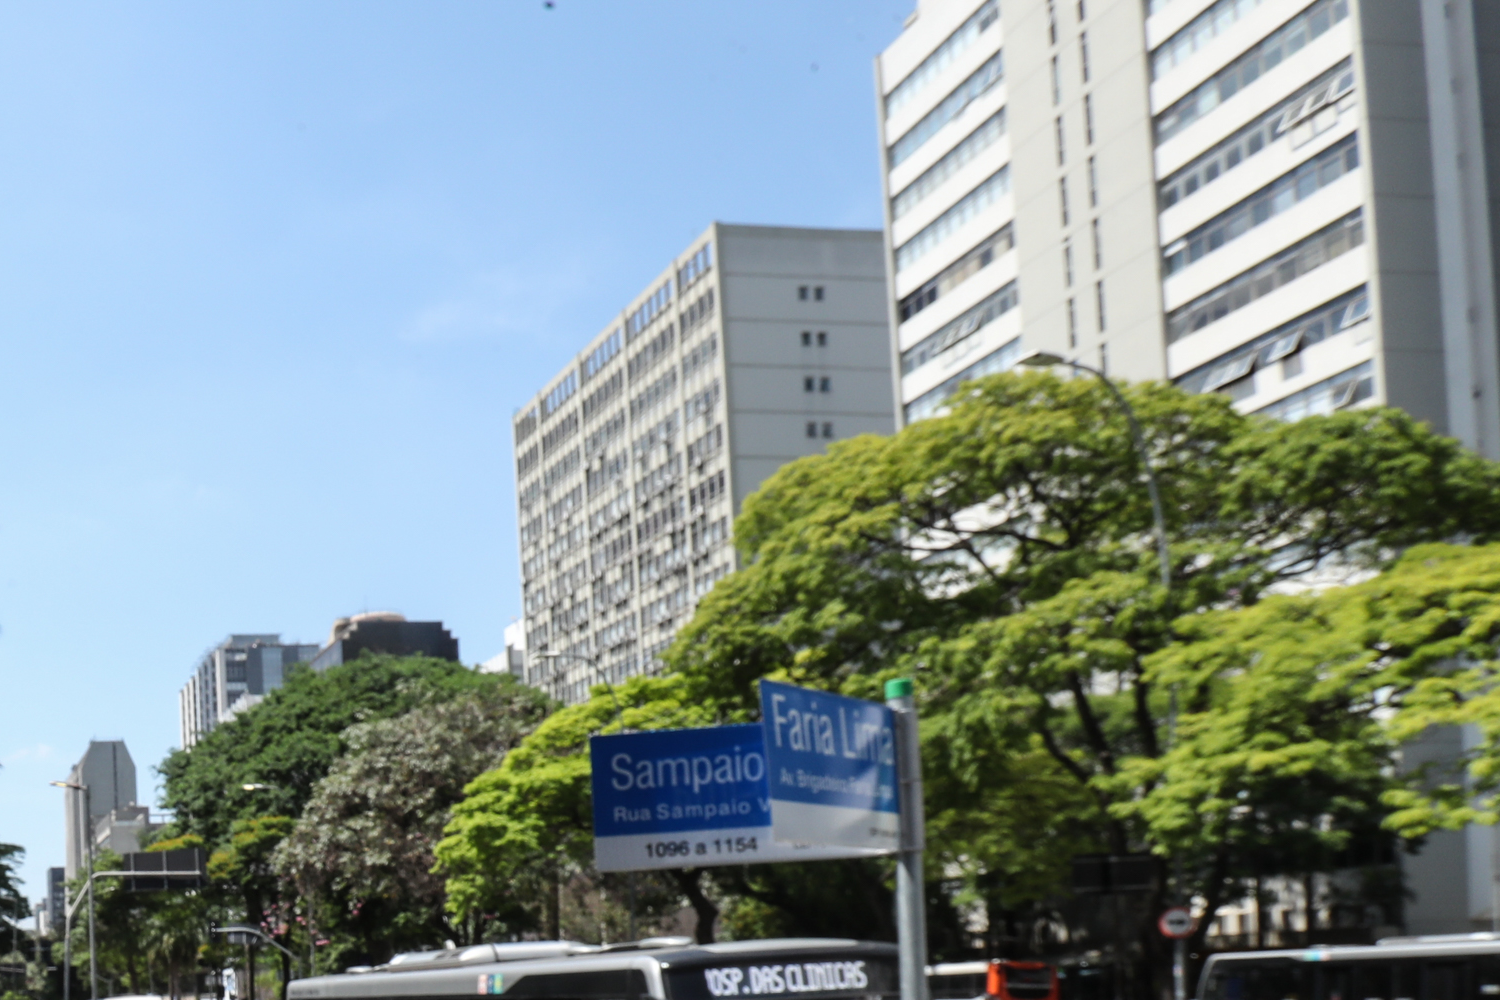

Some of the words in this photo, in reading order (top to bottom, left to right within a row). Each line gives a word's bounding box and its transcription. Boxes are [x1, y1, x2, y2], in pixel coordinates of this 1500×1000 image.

[771, 692, 836, 757] Faria
[838, 706, 894, 766] Lima
[611, 745, 766, 793] Sampaio
[614, 804, 650, 822] Rua
[656, 798, 751, 820] Sampaio
[646, 840, 690, 858] 1096
[695, 842, 708, 856] a
[714, 836, 759, 854] 1154
[749, 964, 785, 994] DAS
